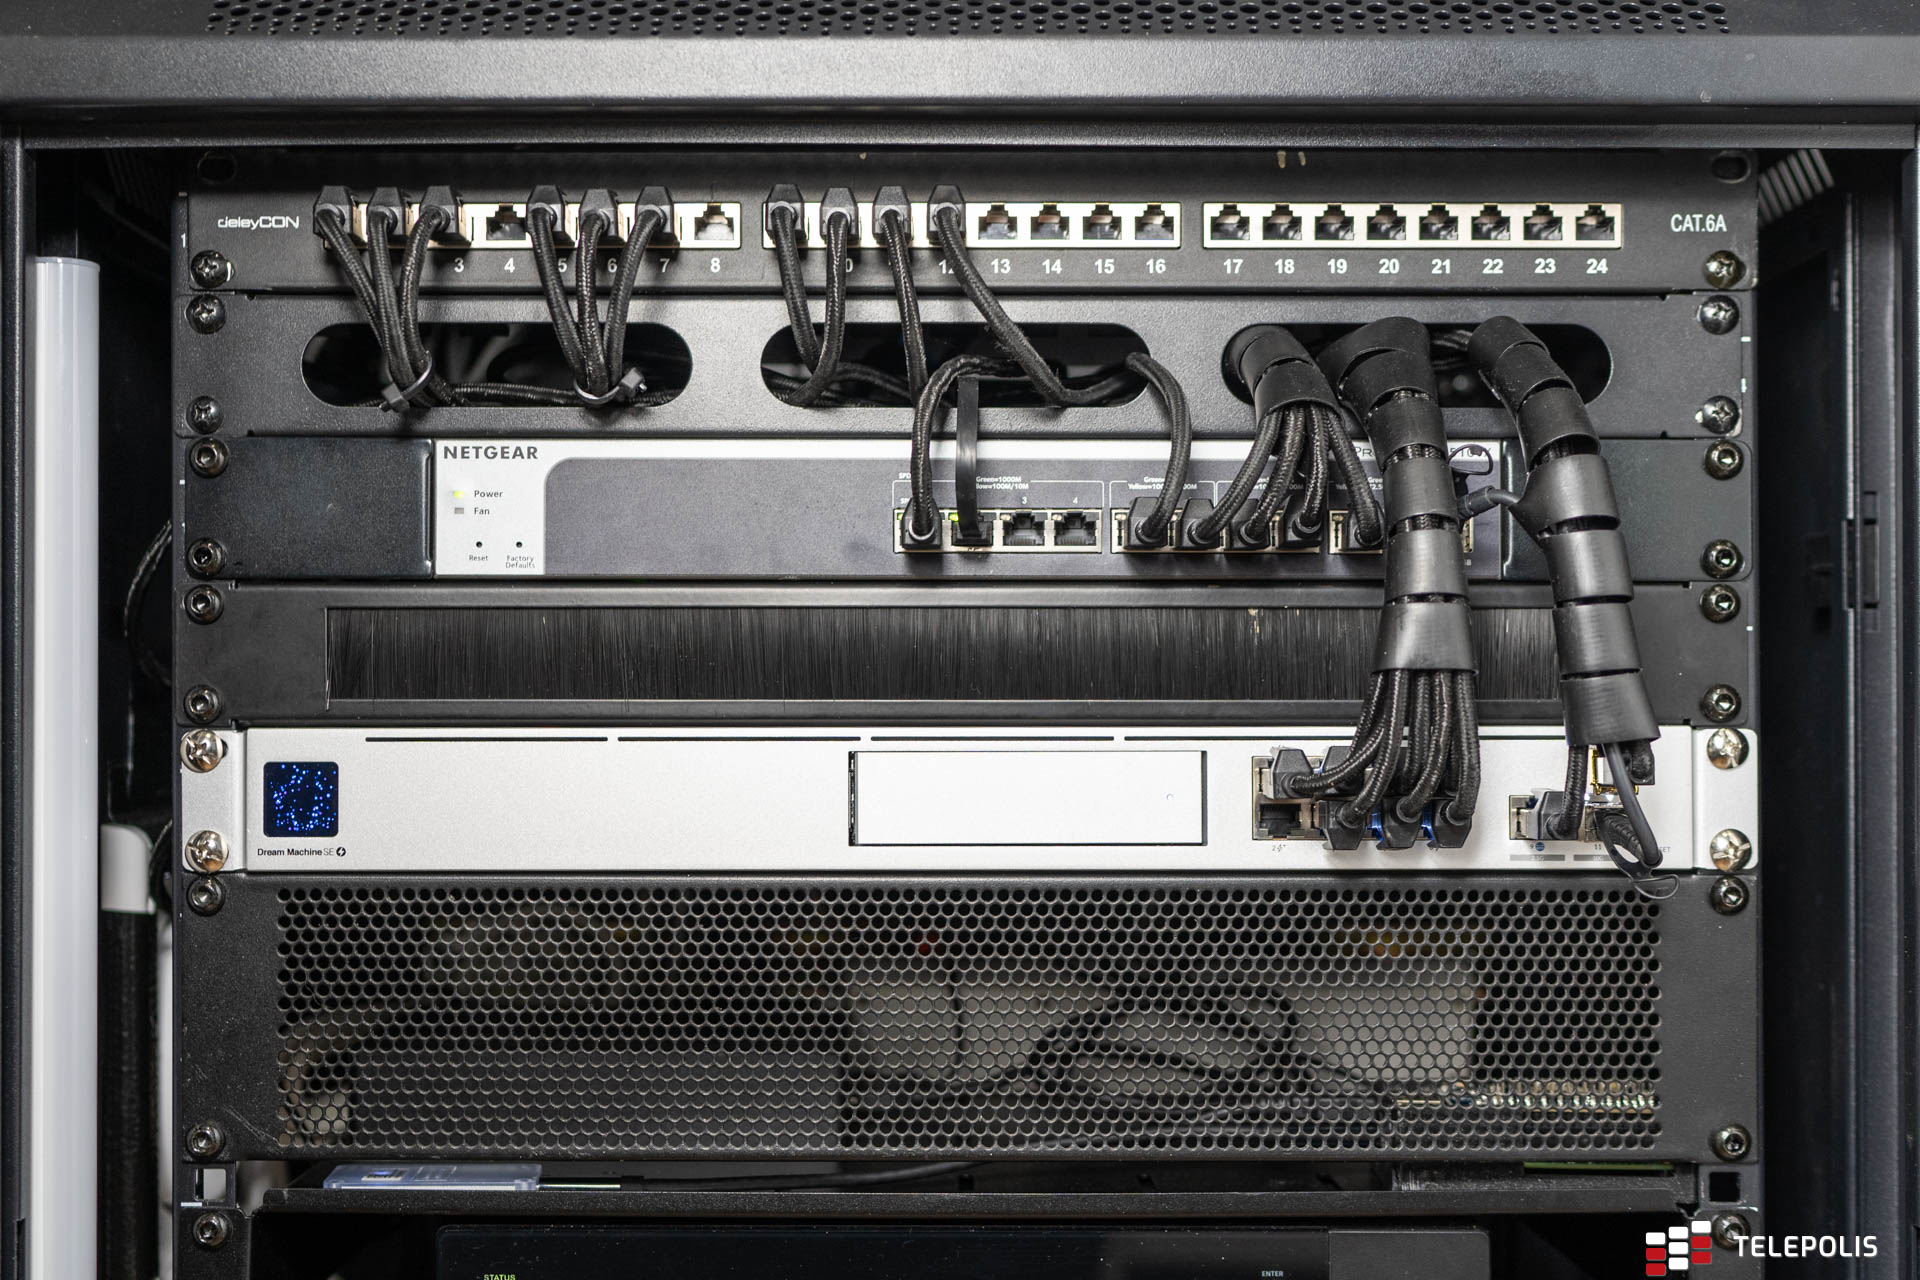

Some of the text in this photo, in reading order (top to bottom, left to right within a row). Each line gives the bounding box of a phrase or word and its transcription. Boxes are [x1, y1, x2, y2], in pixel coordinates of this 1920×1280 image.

[218, 215, 300, 230] deleyCON
[1671, 213, 1727, 232] CAT.6A
[454, 257, 720, 273] 3 4 5 6 7 8
[939, 259, 954, 274] 1
[991, 259, 1011, 274] 13
[1042, 259, 1062, 274] 14
[1095, 259, 1114, 274] 15
[1146, 259, 1166, 274] 16
[1224, 259, 1608, 274] 17 18 19 20 21 22 23 24
[444, 446, 538, 459] NETGEAR
[474, 490, 503, 498] Power
[1022, 496, 1028, 504] 3
[1072, 496, 1079, 504] 4
[474, 507, 490, 515] Fan
[507, 555, 534, 563] Factory
[257, 848, 334, 856] Dream Machine SE
